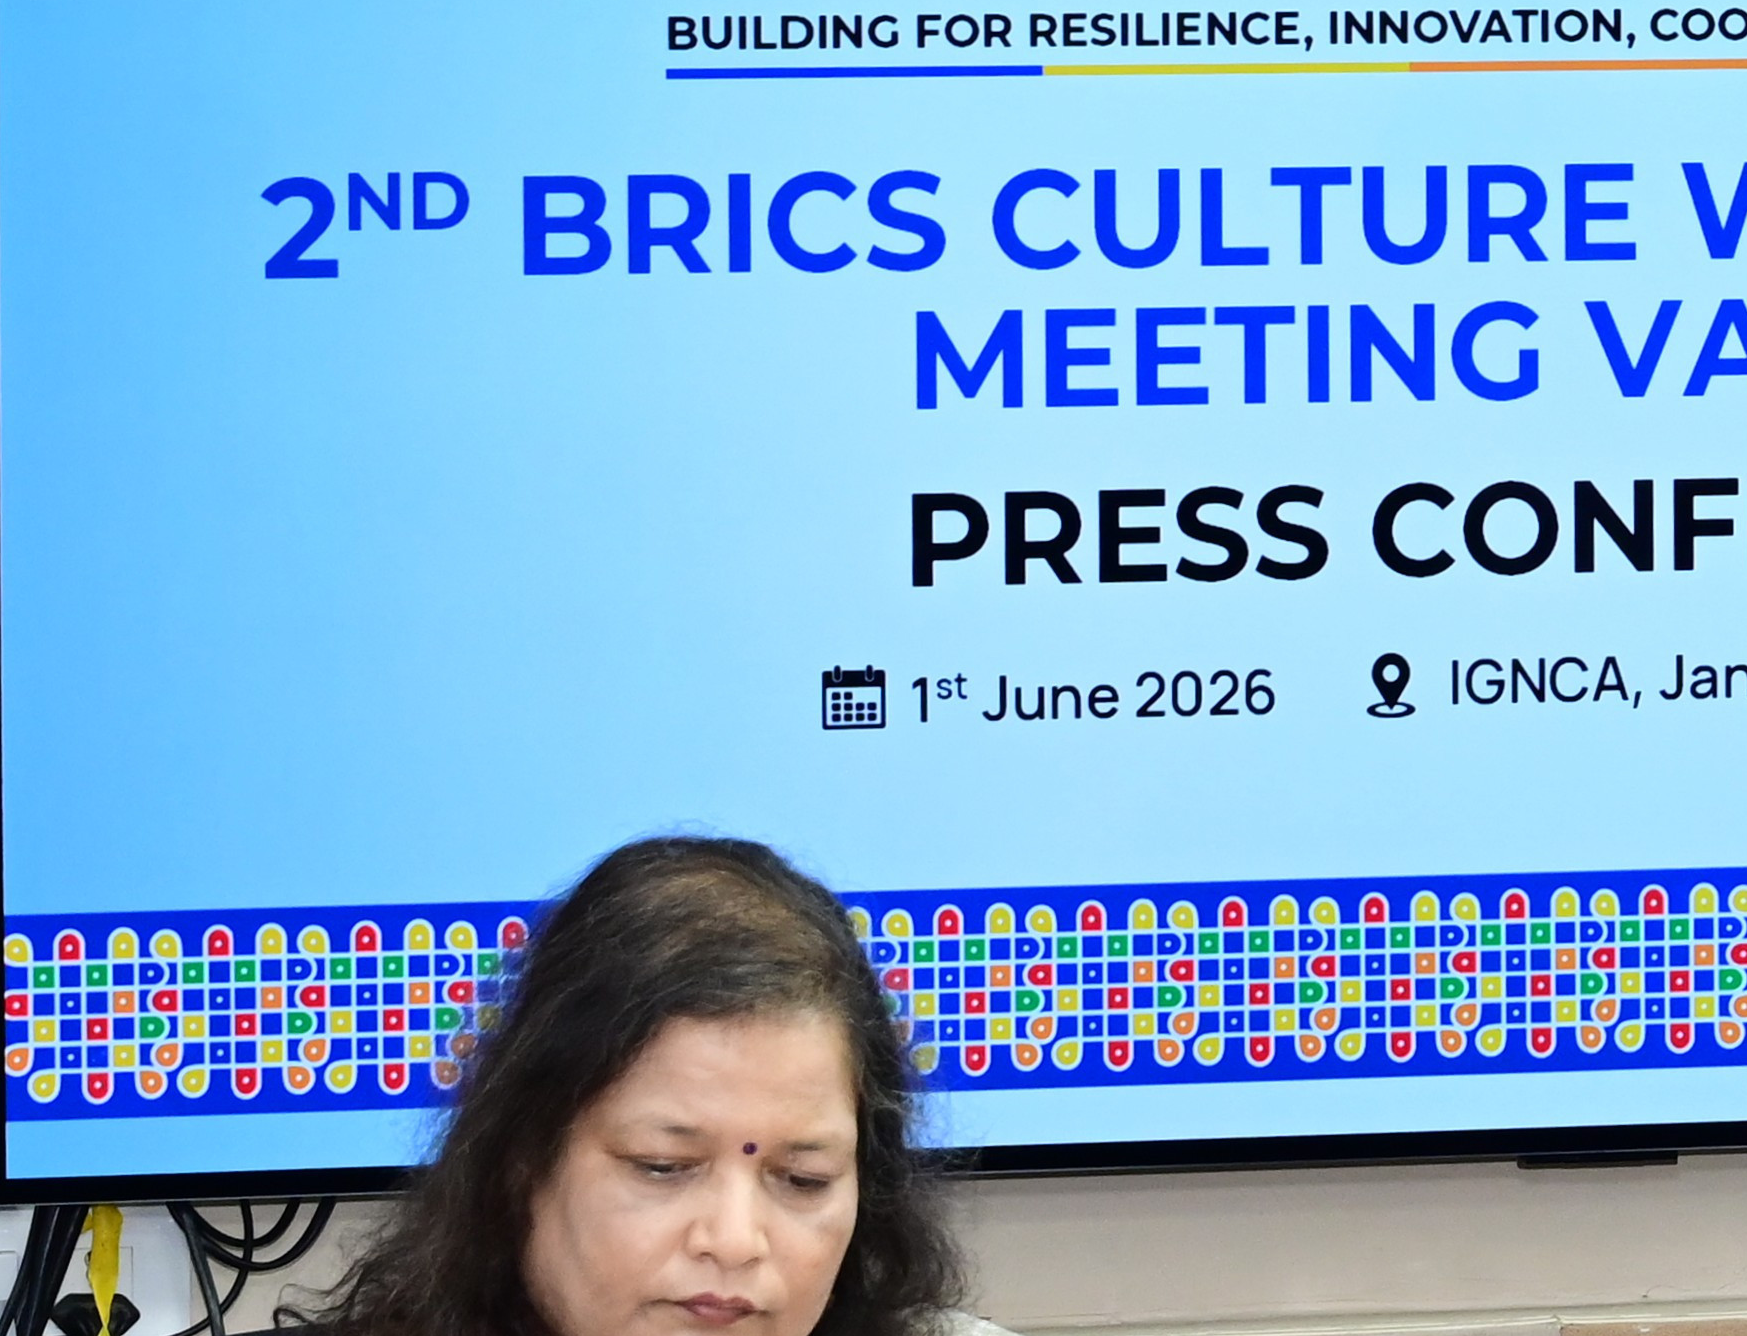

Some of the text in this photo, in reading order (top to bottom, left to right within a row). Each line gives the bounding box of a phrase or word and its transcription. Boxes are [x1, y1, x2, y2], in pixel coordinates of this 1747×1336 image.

[667, 14, 899, 51] BUILDING
[917, 13, 1013, 49] FOR
[1029, 10, 1314, 53] RESILIENCE,
[1329, 8, 1636, 50] INNOVATION,
[260, 171, 471, 280] 2ND
[522, 169, 947, 276] BRICS
[991, 163, 1637, 271] CULTURE
[915, 300, 1540, 410] MEETING
[910, 483, 1330, 588] PRESS
[911, 668, 1276, 724] 1st June 2026
[1451, 655, 1642, 710] IGNCA,
